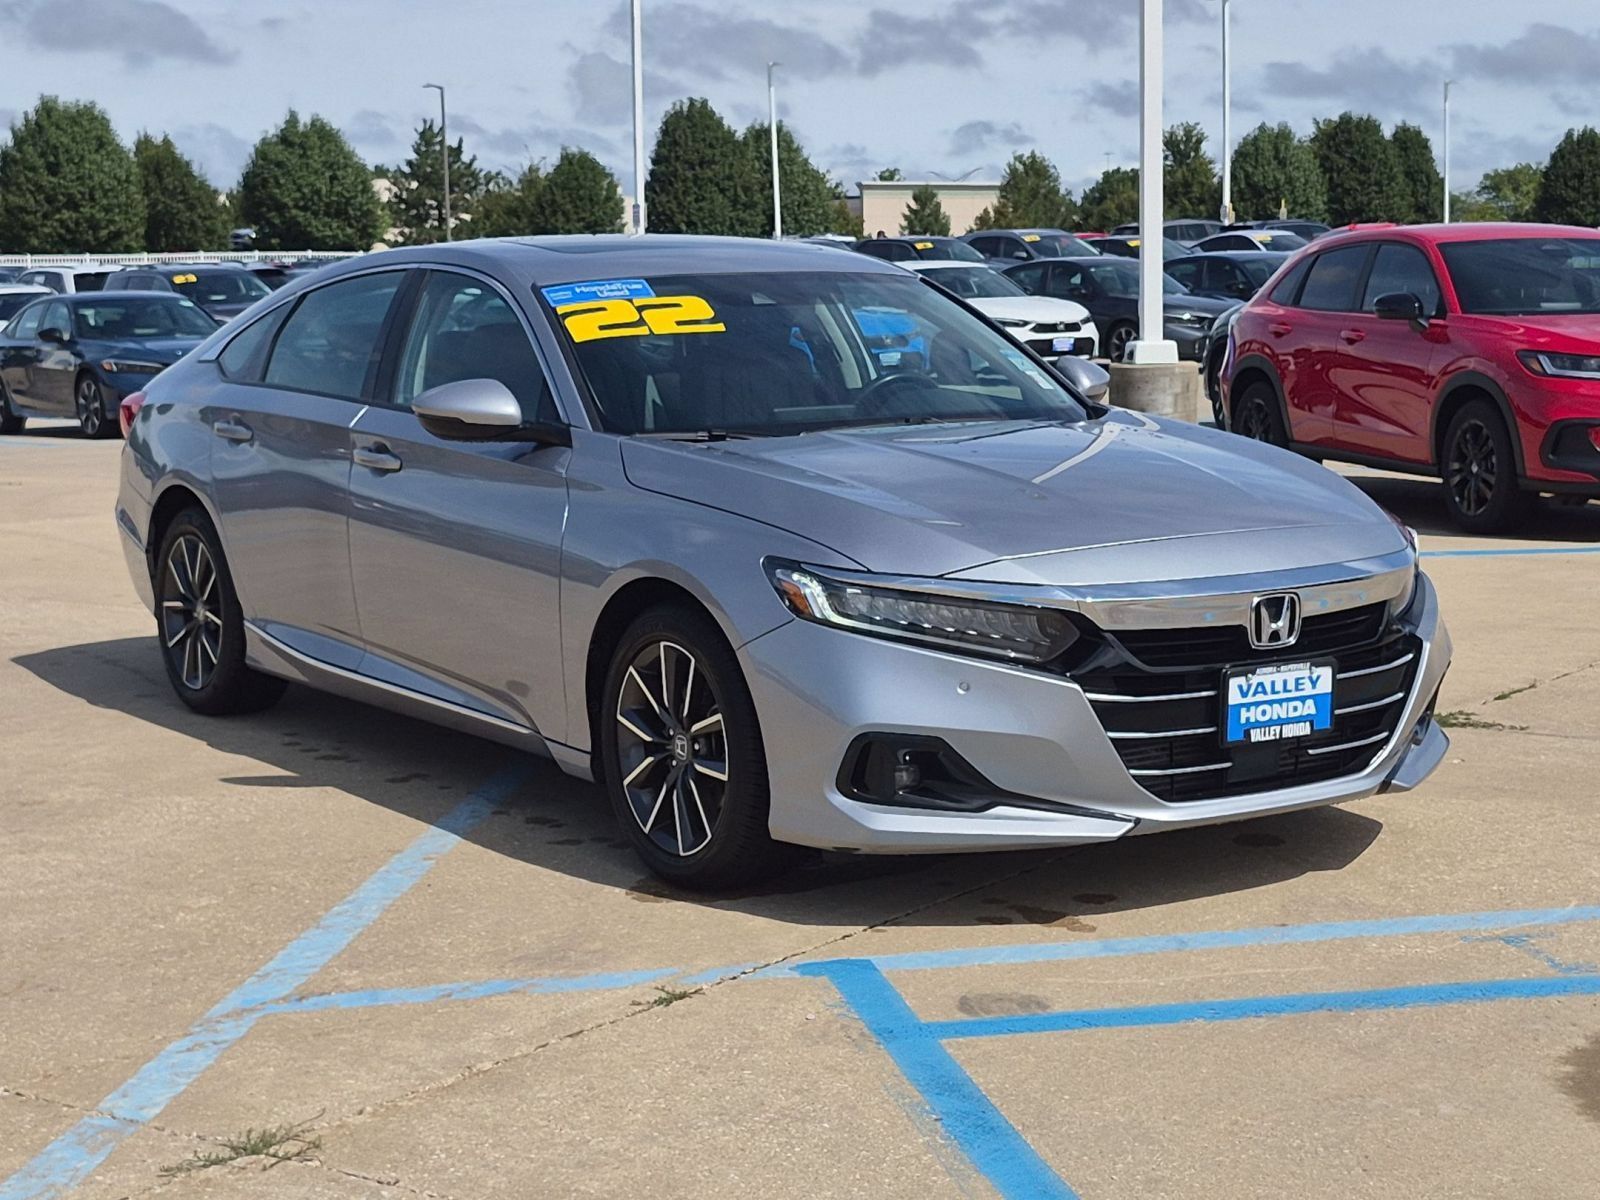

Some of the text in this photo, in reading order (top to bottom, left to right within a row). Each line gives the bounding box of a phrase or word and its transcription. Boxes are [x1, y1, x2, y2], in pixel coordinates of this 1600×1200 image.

[556, 295, 727, 343] 22
[1237, 674, 1321, 699] VALLEY
[1240, 699, 1317, 724] HONDA
[1250, 720, 1311, 743] VALLEY HONDA
